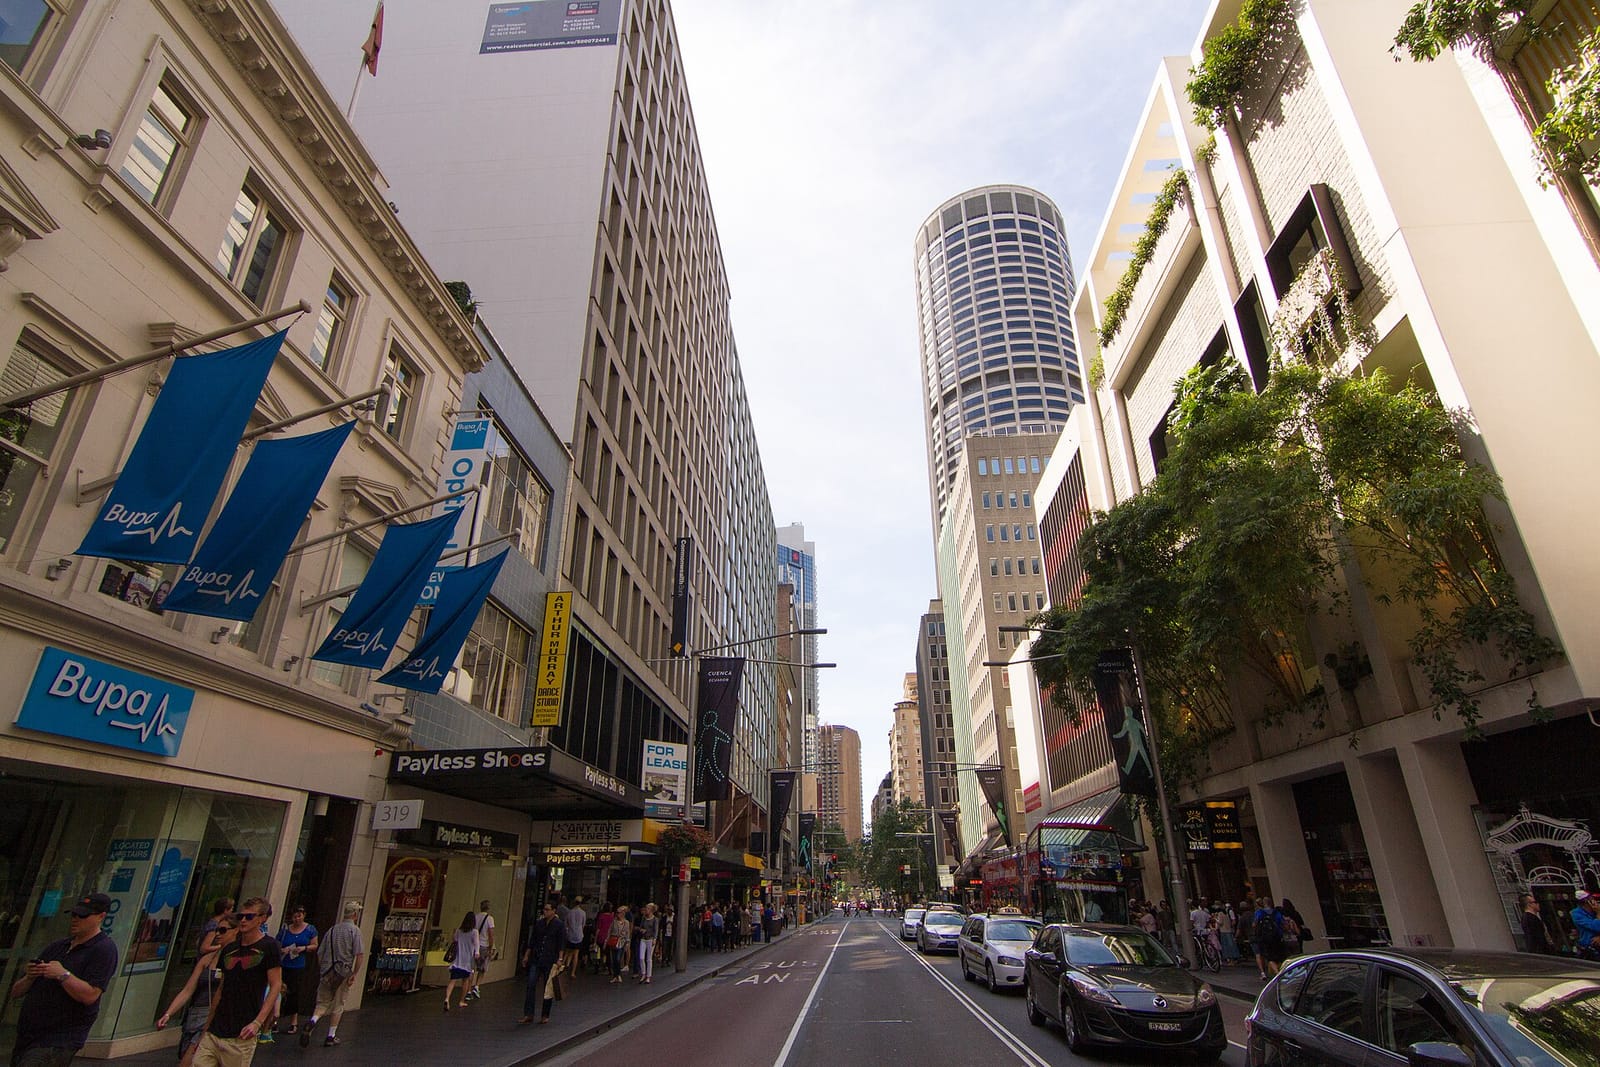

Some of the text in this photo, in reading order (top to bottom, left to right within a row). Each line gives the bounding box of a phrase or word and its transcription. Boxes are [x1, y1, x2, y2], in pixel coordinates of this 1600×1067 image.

[456, 423, 477, 431] Bupa
[104, 503, 160, 528] Bupa
[184, 566, 232, 586] Bupa
[546, 595, 564, 685] ARTHUR MURRAY
[48, 658, 154, 717] Bupa
[537, 687, 560, 697] DANCE
[536, 697, 559, 707] STUDIO
[647, 744, 674, 756] FOR
[397, 751, 546, 775] Payless Shoes
[646, 757, 688, 770] LEASE
[585, 765, 625, 796] Payless Shes
[381, 805, 410, 821] 319
[567, 823, 622, 832] ANYTIME
[436, 826, 493, 847] Payless Shes
[567, 832, 621, 840] FITNESS
[113, 841, 150, 850] LOCATED
[546, 854, 582, 864] Payless
